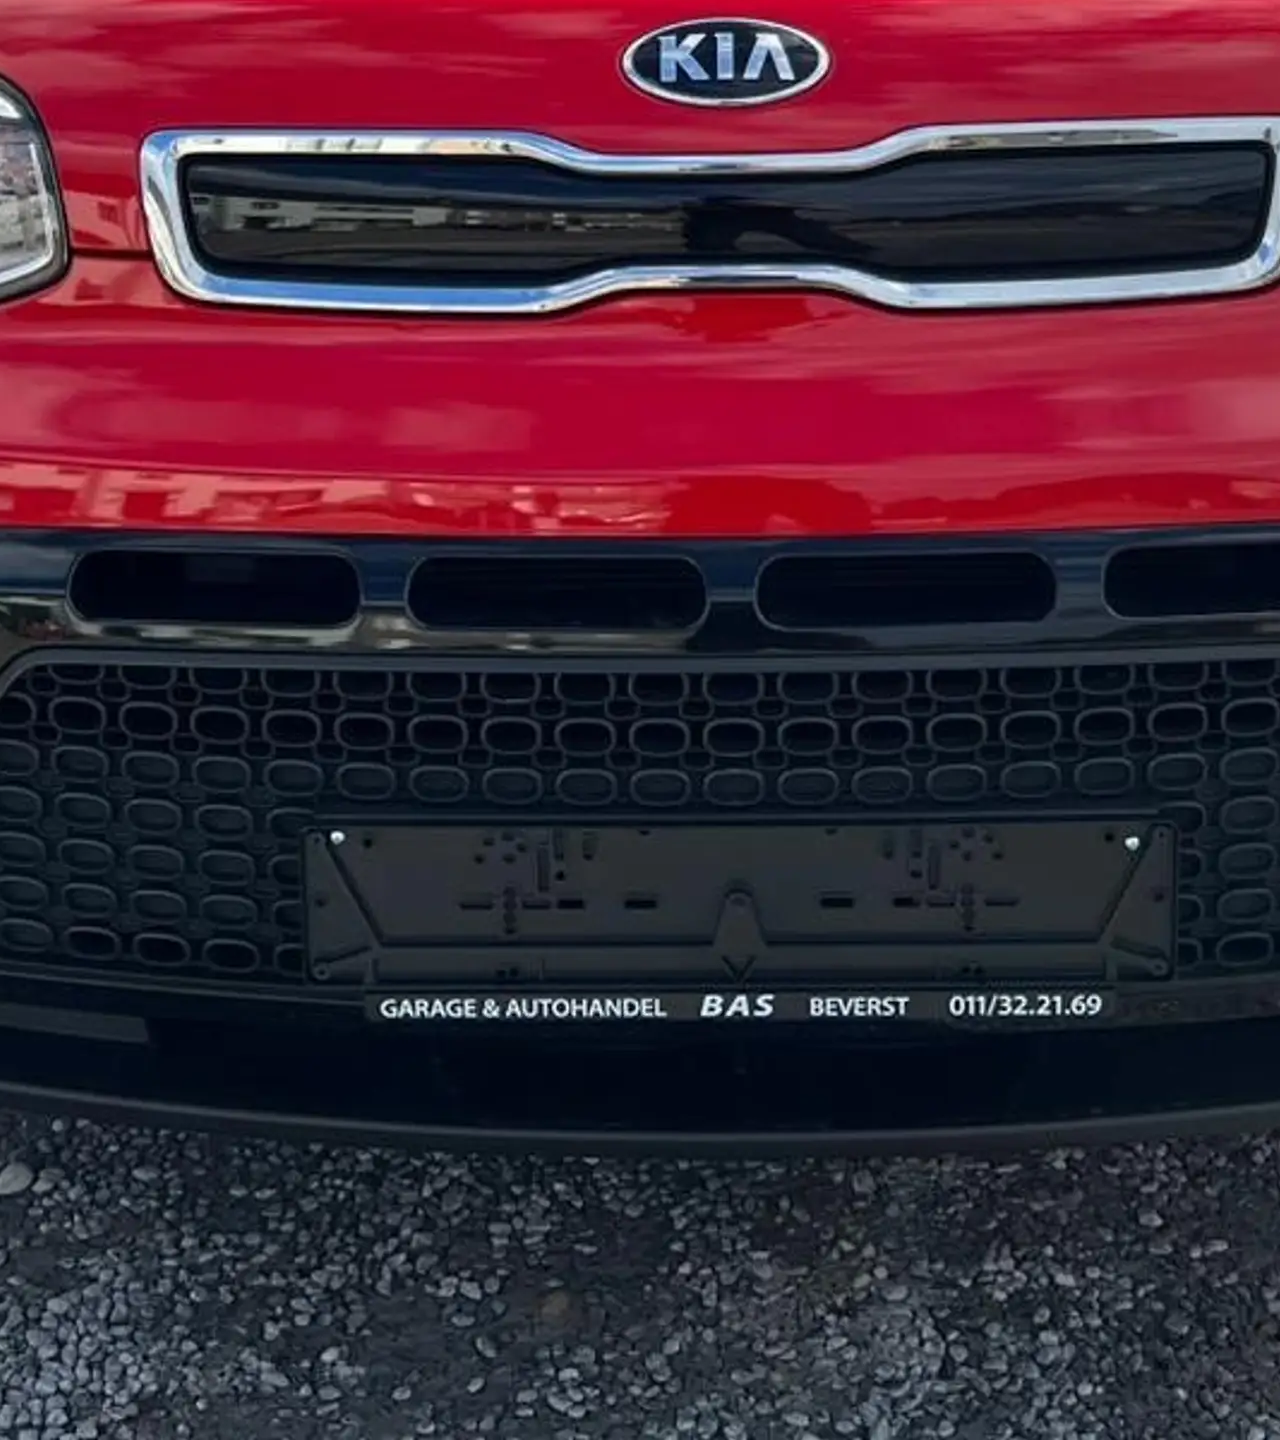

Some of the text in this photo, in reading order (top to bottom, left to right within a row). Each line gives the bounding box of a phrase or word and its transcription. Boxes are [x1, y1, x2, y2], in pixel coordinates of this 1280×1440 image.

[658, 31, 796, 83] KIA
[379, 994, 1103, 1019] GARAGE & AUTOHANDEL BAS BEVERST 011/32.21.69
